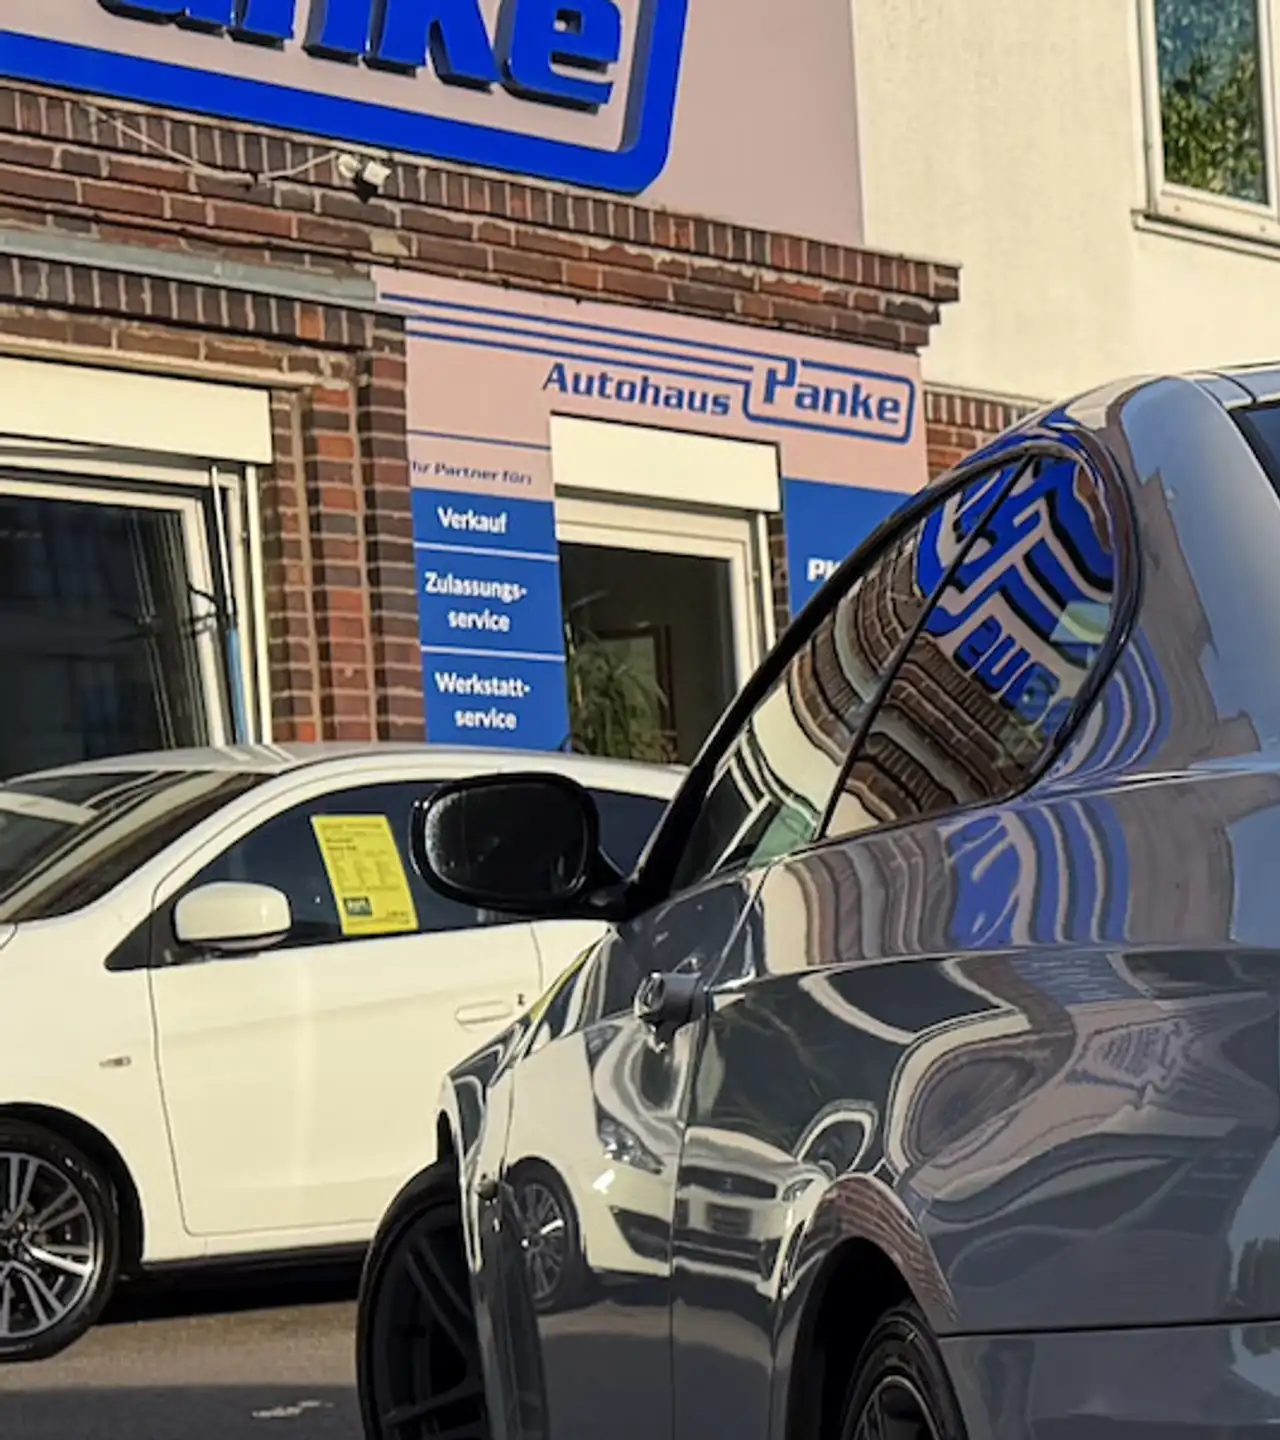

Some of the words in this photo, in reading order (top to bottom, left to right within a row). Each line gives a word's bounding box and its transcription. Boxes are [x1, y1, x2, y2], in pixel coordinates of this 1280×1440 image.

[542, 362, 731, 416] Autohaus
[763, 359, 901, 424] Panke
[434, 462, 500, 481] Partner
[437, 506, 508, 534] Verkauf
[424, 571, 528, 603] Zulassungs-
[448, 609, 511, 632] service
[434, 671, 531, 698] Werkstatt-
[454, 708, 518, 730] service
